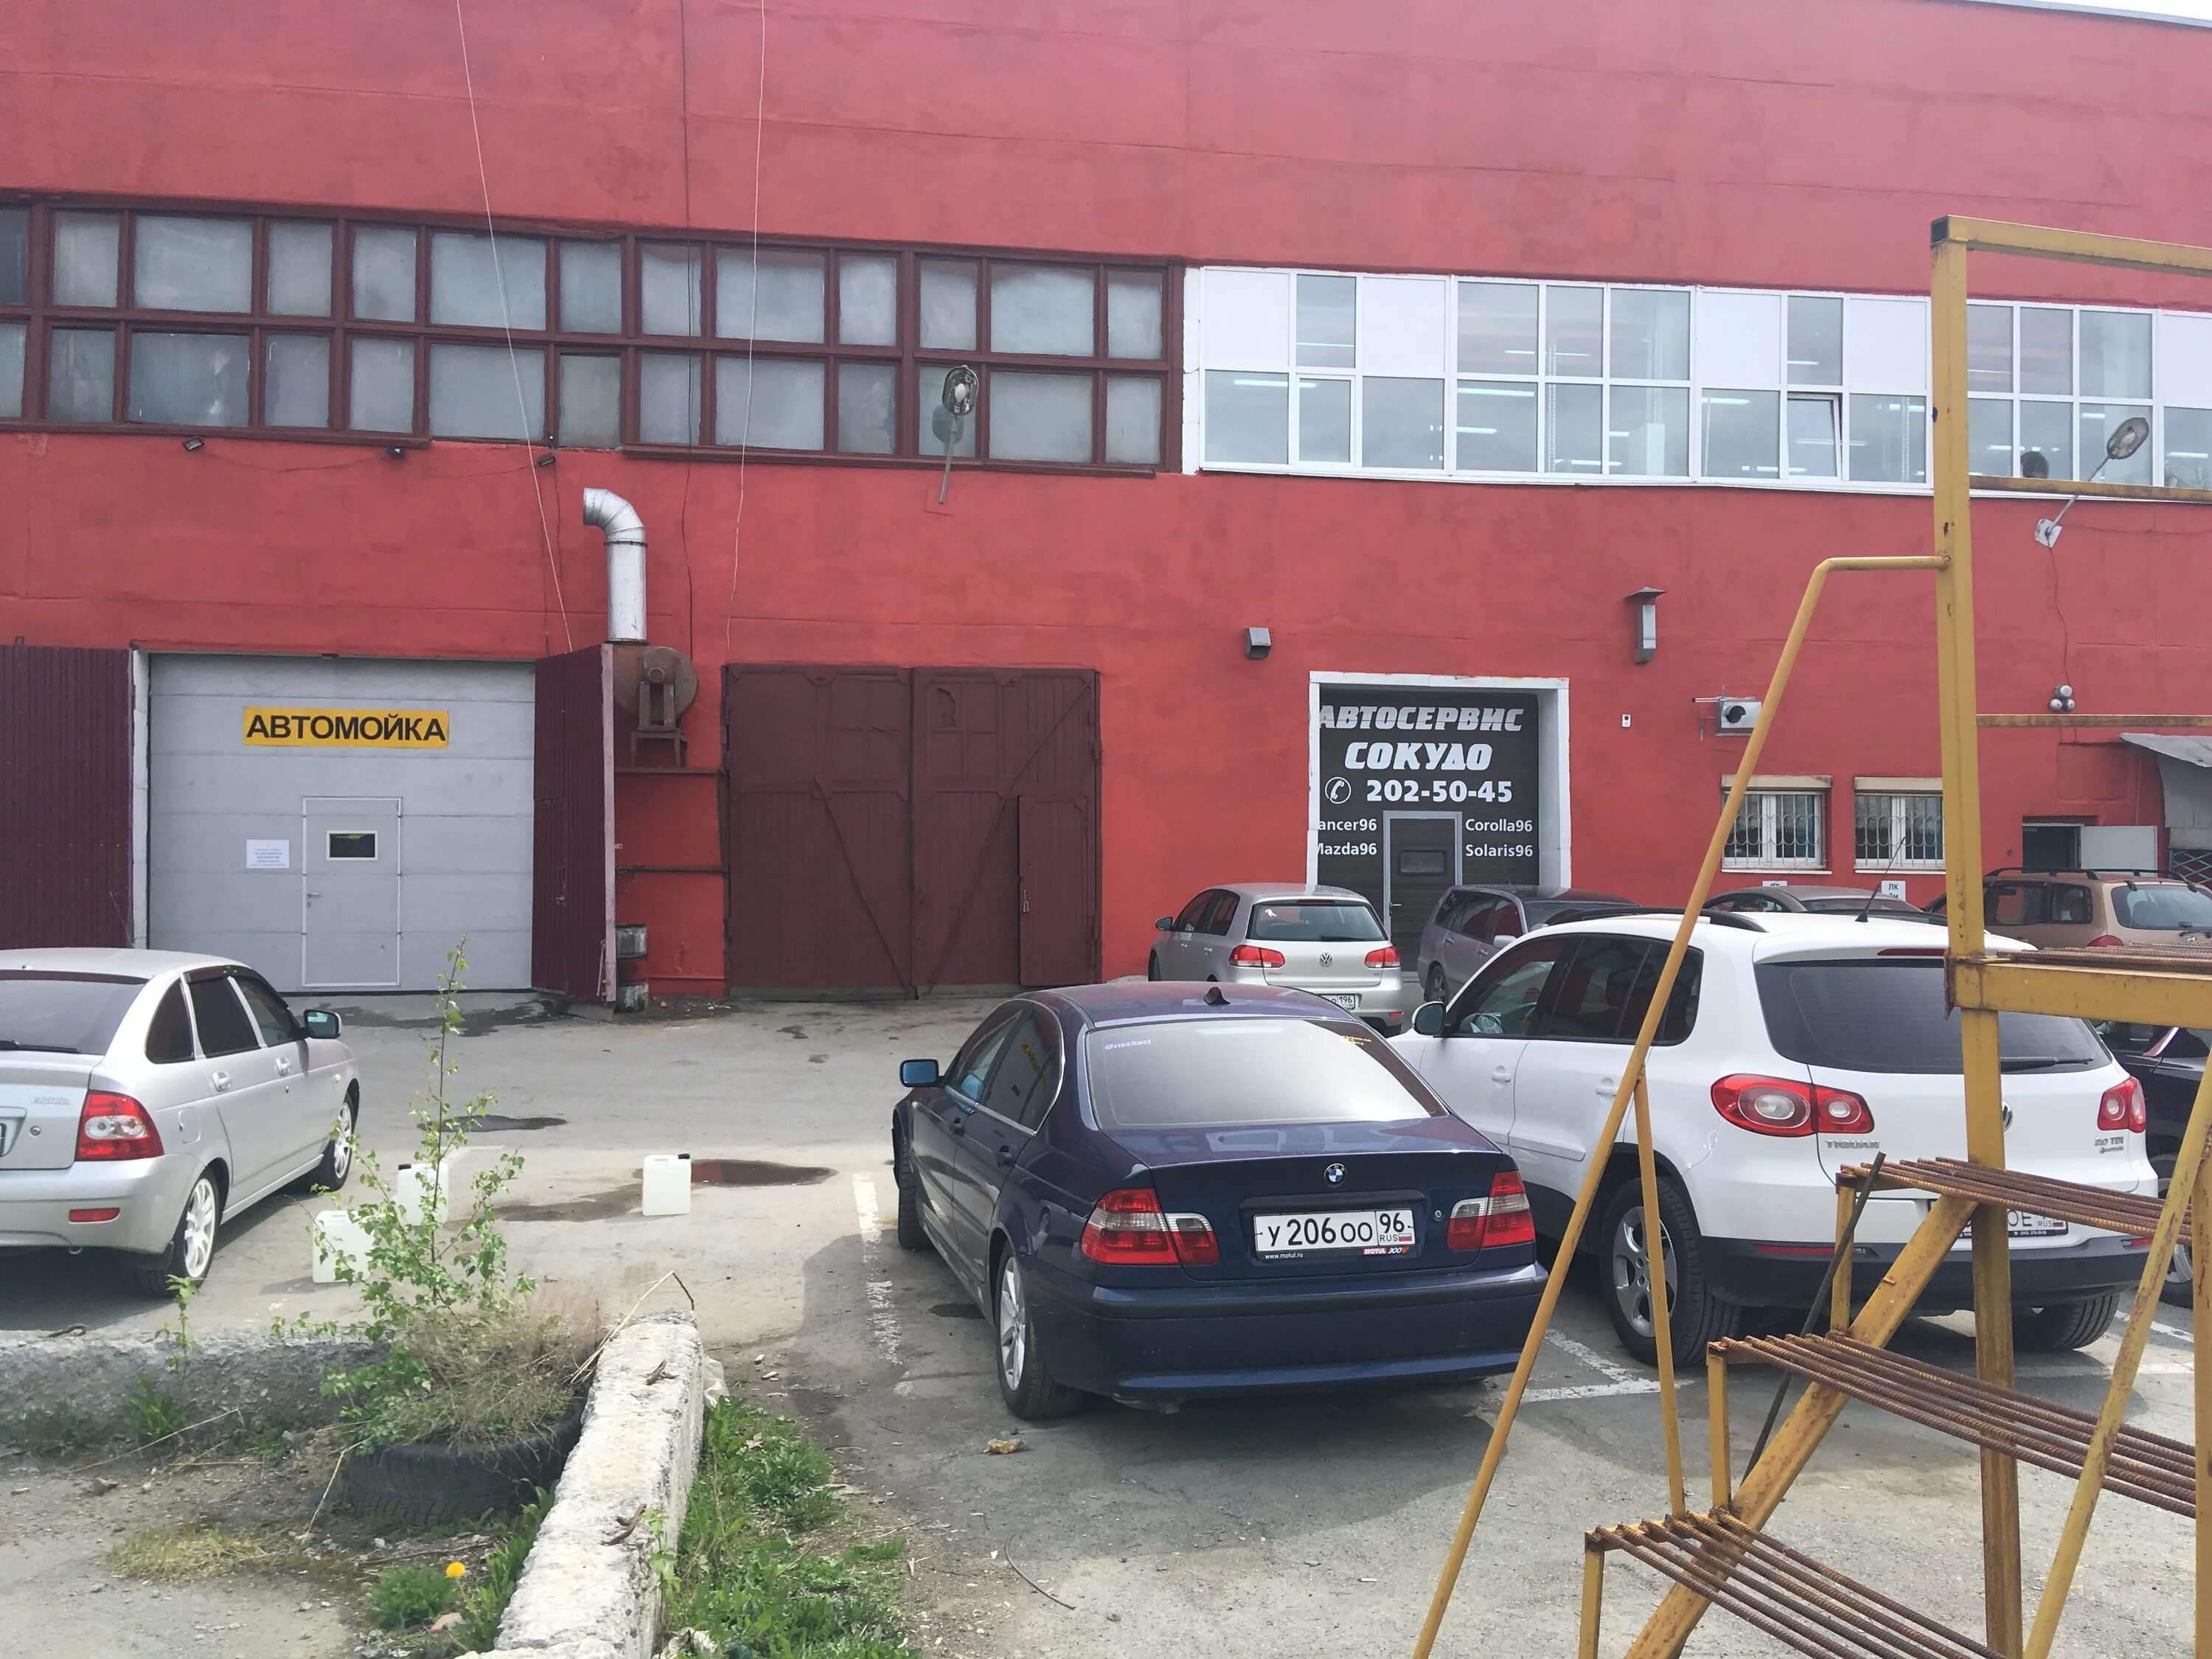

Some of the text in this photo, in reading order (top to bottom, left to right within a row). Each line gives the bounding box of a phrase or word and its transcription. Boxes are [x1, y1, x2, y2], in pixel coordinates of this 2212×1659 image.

[1319, 705, 1524, 731] АВТОСЕРВИС
[246, 713, 446, 741] АВТОМОЙКА
[1344, 742, 1492, 771] СОКУДО
[1366, 779, 1512, 803] 202-50-45
[1319, 818, 1377, 831] ancer96
[1465, 818, 1533, 832] Corolla96
[1465, 844, 1534, 857] Solaris96
[1826, 1140, 1879, 1149] TIGUAN
[1379, 1213, 1405, 1234] 96
[1380, 1234, 1398, 1242] RUS
[1265, 1252, 1304, 1260] www.motul.ru
[1363, 1246, 1411, 1255] MOTUL 300V
